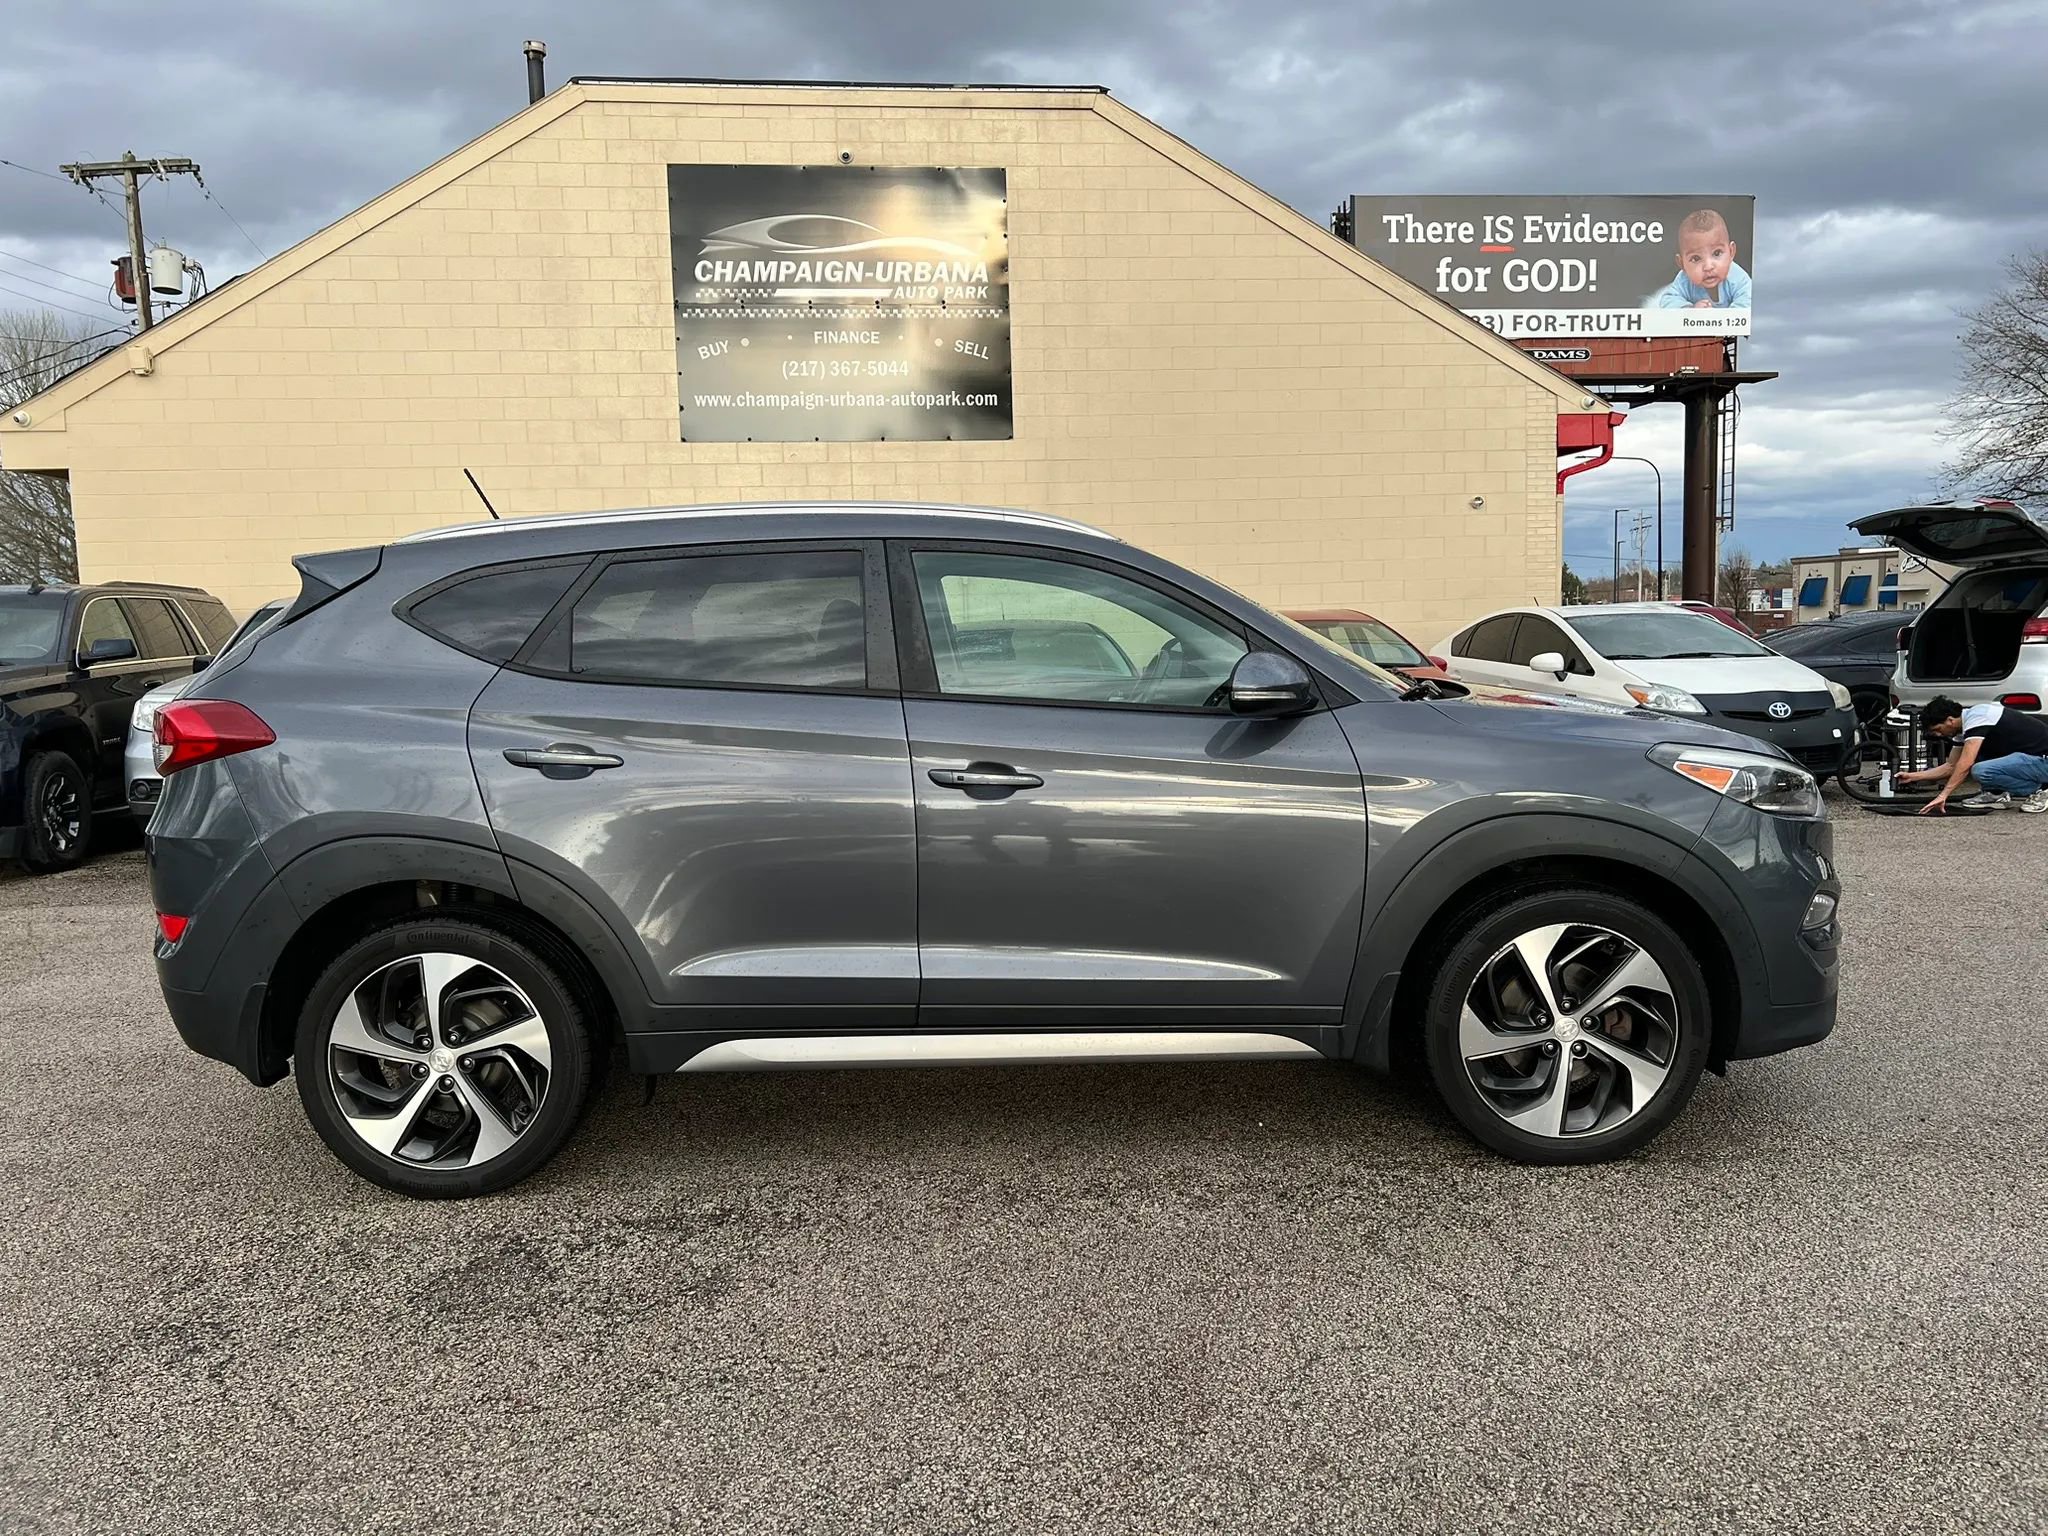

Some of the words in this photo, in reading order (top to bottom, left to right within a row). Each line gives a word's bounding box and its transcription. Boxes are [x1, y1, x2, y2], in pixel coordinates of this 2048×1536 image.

[1382, 213, 1474, 243] There
[1482, 215, 1514, 243] IS
[1522, 213, 1664, 243] Evidence
[694, 259, 989, 284] CHAMPAIGN-URBANA
[1435, 256, 1491, 293] for
[1502, 258, 1597, 293] GOD!
[893, 286, 939, 299] AUTO
[944, 285, 989, 299] PARK
[1512, 314, 1642, 332] FOR-TRUTH
[1683, 318, 1723, 327] Romans
[1726, 318, 1747, 327] 1:20
[698, 340, 729, 360] BUY
[813, 331, 881, 345] FINANCE
[954, 339, 990, 360] SELL
[782, 360, 826, 380] (217)
[830, 360, 909, 377] 367-5044
[694, 391, 999, 411] www.champaign-urbana-autopark.com
